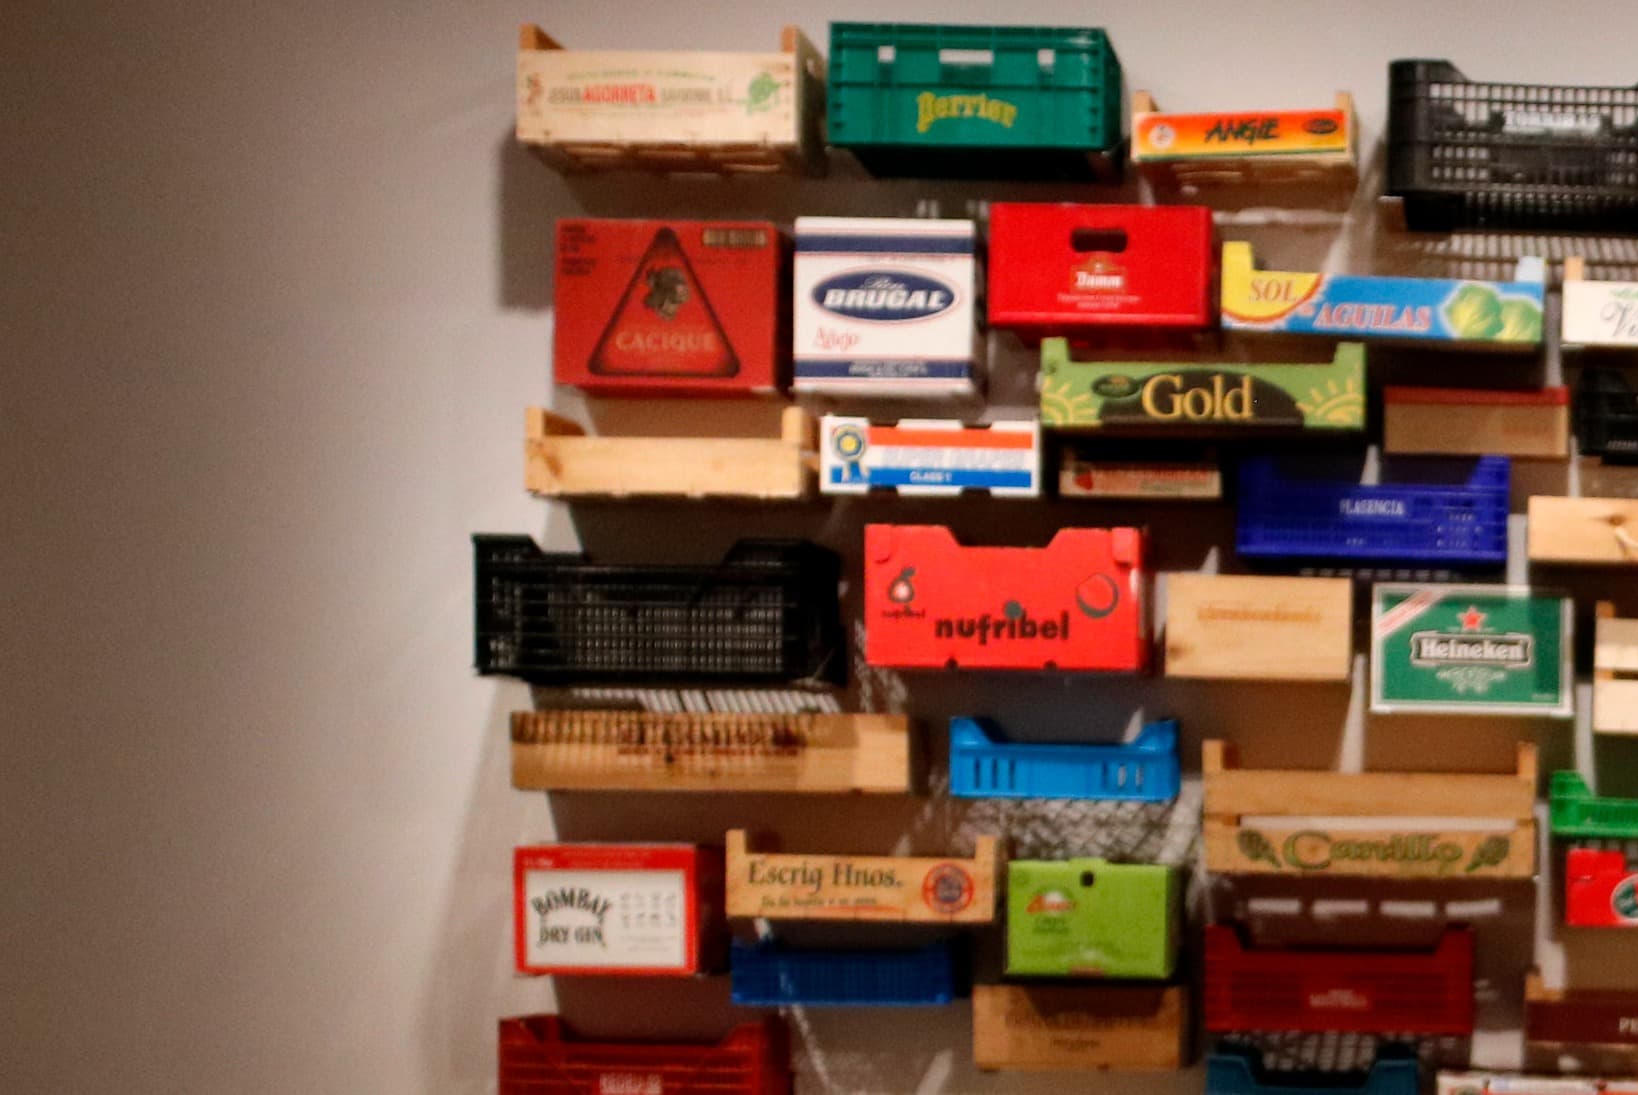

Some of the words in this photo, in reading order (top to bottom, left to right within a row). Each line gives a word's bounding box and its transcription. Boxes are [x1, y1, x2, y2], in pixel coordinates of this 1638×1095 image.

[916, 92, 1018, 133] Perrier
[1204, 116, 1279, 147] ANGIE
[1075, 271, 1123, 290] Damm
[1248, 278, 1299, 303] SOL
[822, 288, 948, 311] BRUGAL
[616, 330, 718, 354] CACIQUE
[1141, 374, 1254, 420] Gold
[935, 608, 1069, 645] nufribel
[1419, 637, 1526, 661] Heineken
[748, 861, 823, 892] Escrig
[832, 863, 904, 888] Hnos.
[531, 887, 613, 918] BOMBAY
[538, 924, 570, 947] DRY
[574, 924, 607, 947] GIN
